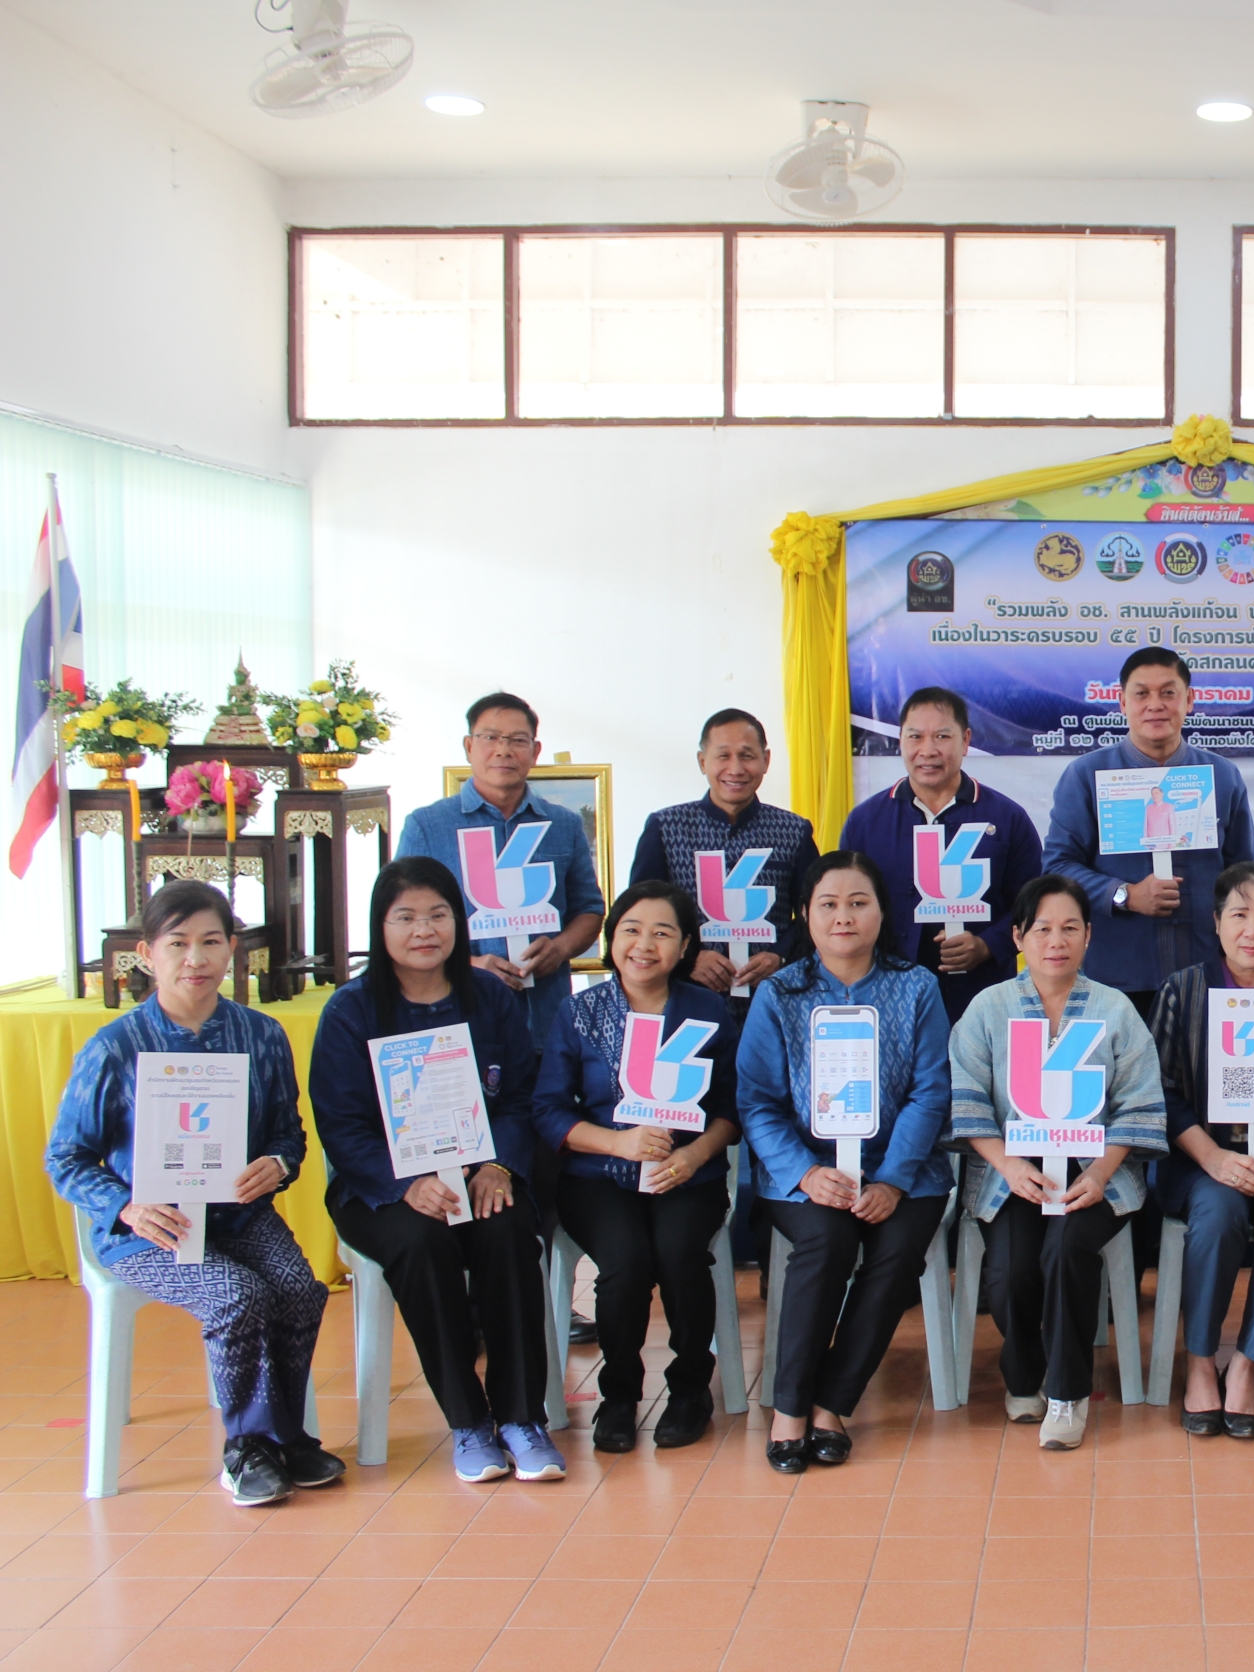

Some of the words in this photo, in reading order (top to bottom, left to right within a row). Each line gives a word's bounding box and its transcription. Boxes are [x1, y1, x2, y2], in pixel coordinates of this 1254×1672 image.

[986, 597, 1069, 619] “รวมพลัง
[1079, 602, 1108, 619] อช.
[1119, 599, 1238, 620] สานพลังแก้จน
[931, 621, 1098, 644] เนื่องในวาระครบรอบ
[1109, 627, 1136, 644] ๕๕
[1148, 624, 1162, 644] ปี
[1192, 686, 1251, 701] กราคม
[1062, 717, 1077, 727] ณ
[1033, 730, 1064, 749] หมู่ที่
[1071, 735, 1092, 747] ๑๒
[1165, 774, 1187, 782] CLICK
[1171, 780, 1206, 789] CONNECT
[918, 902, 985, 918] คลิกชุมชน
[471, 912, 556, 930] คลิกชุมชน
[702, 924, 771, 940] คลิกชุมชน
[384, 1042, 408, 1052] CLICK
[407, 1040, 419, 1048] TO
[391, 1046, 428, 1058] CONNECT
[619, 1101, 700, 1124] คลิกชุมชน
[1008, 1123, 1103, 1148] คลิกชุมชน
